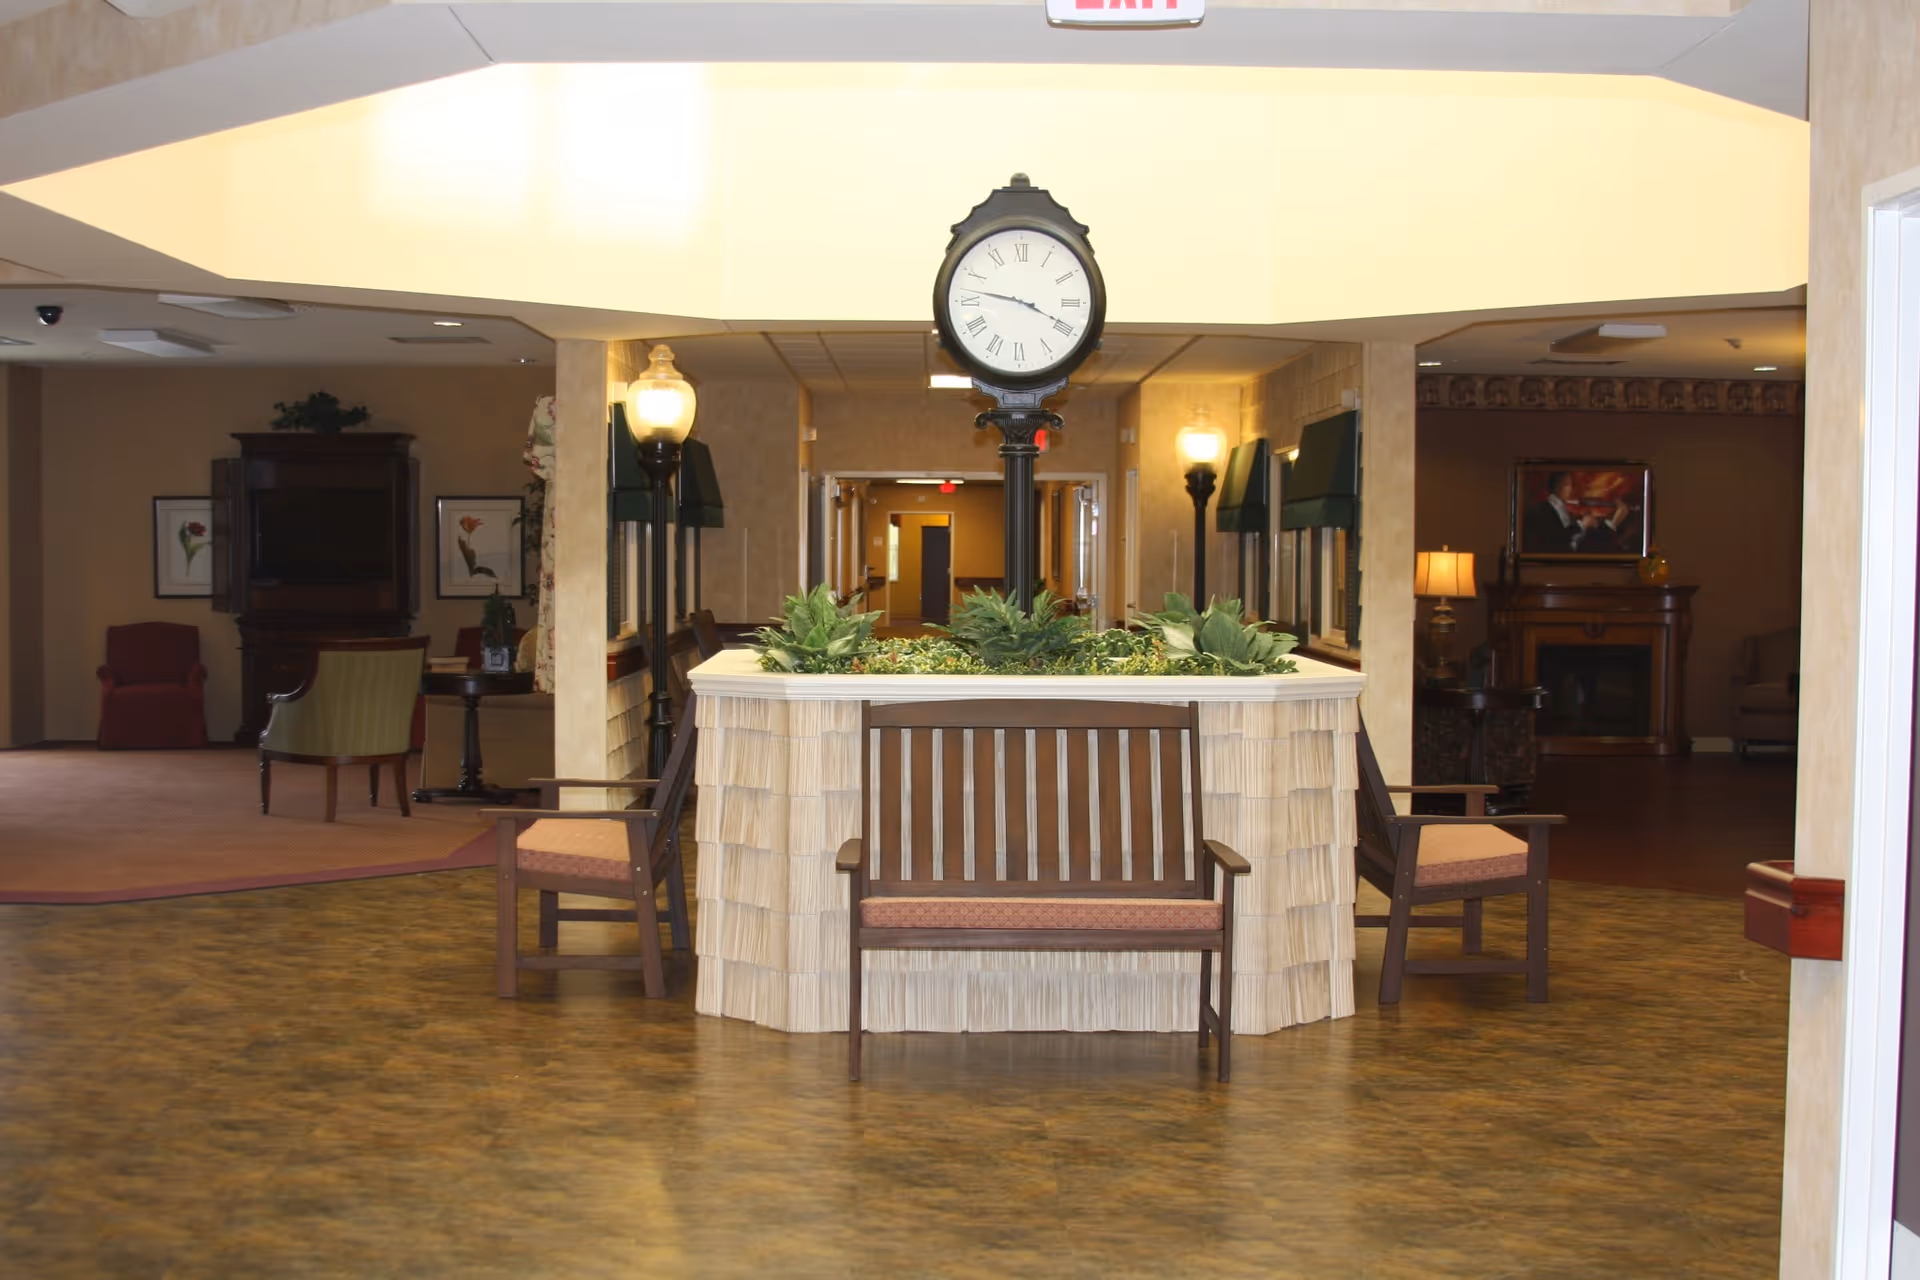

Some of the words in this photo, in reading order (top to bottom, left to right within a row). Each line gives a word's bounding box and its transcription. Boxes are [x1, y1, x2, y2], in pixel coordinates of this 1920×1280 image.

[987, 247, 1005, 269] XI
[1014, 243, 1029, 262] XII
[1040, 251, 1053, 268] I
[1055, 271, 1074, 285] II
[960, 295, 980, 307] IX
[1061, 298, 1080, 308] III
[966, 315, 988, 338] VIII
[985, 334, 1004, 356] VII
[1014, 342, 1025, 361] VI
[1040, 337, 1052, 356] V
